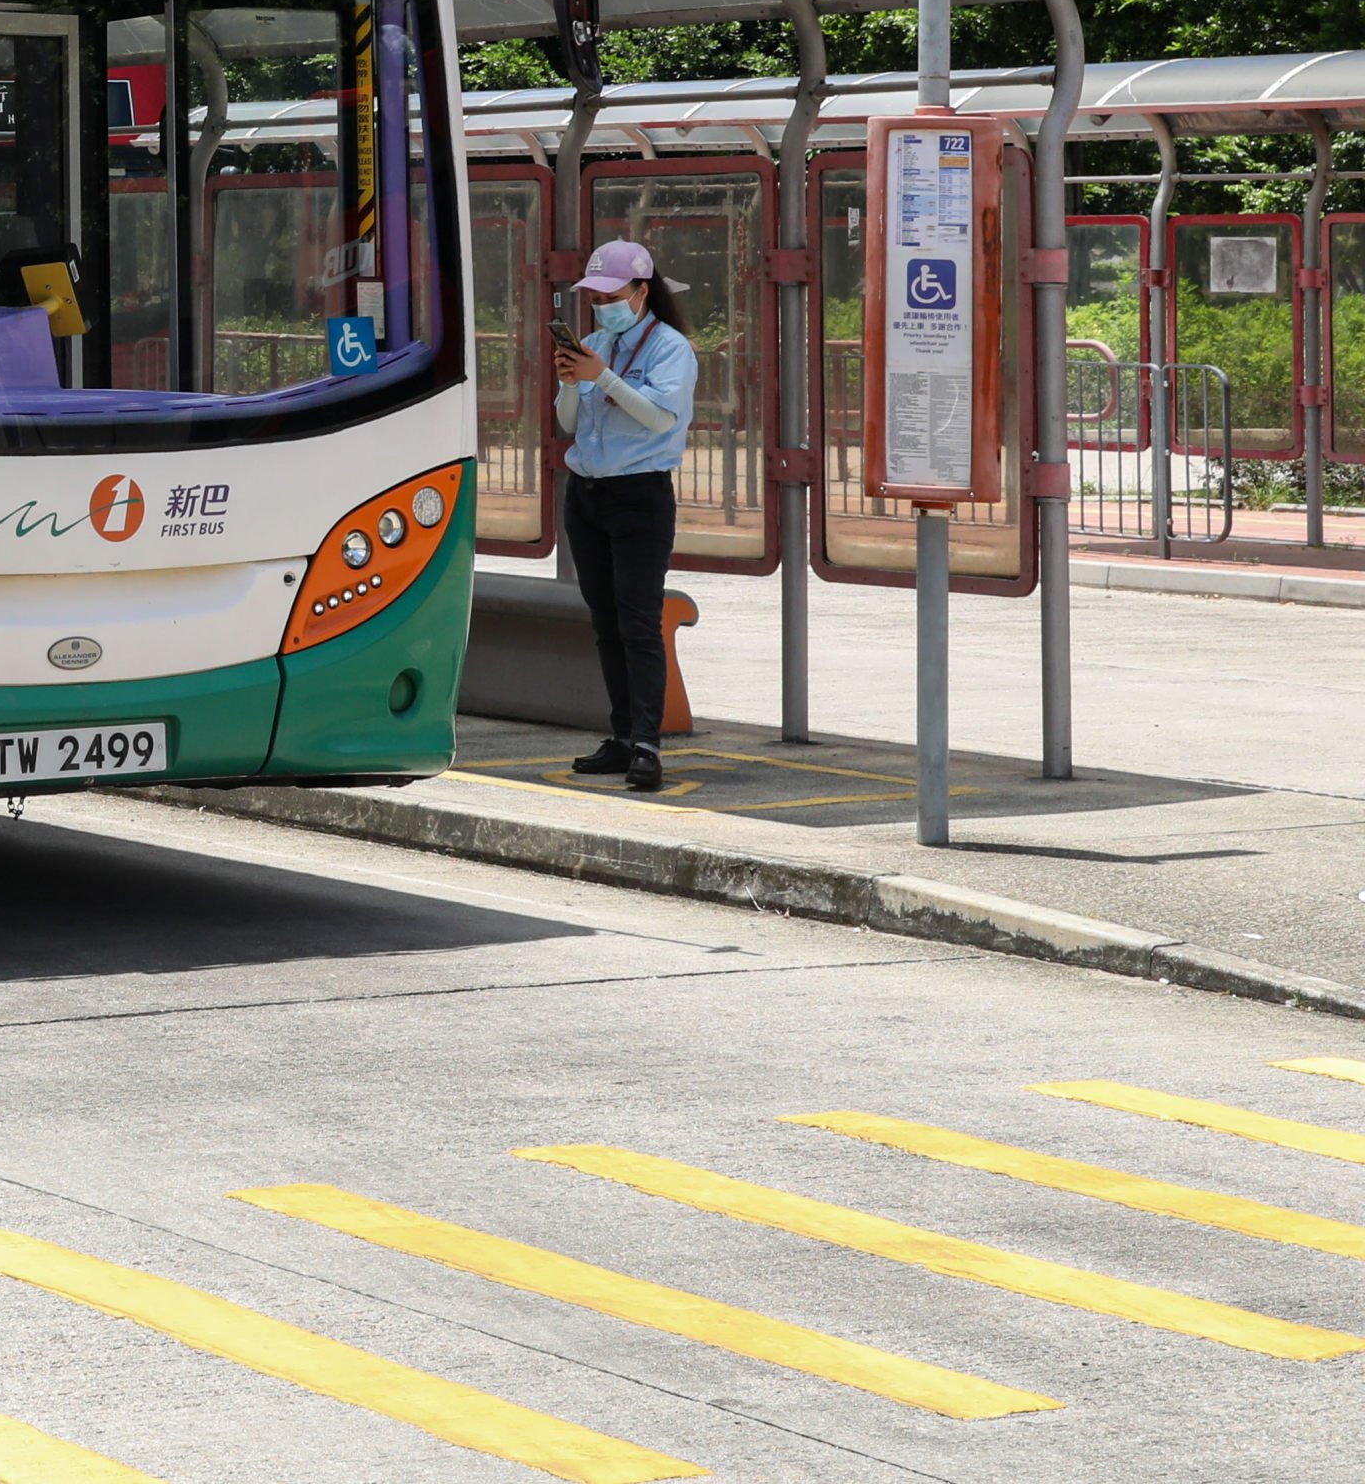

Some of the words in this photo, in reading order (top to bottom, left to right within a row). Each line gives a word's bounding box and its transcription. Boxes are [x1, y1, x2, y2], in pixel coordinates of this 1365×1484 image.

[944, 137, 965, 150] 722
[165, 484, 229, 519] 新巴
[160, 523, 196, 537] FIRST
[199, 522, 224, 535] BUS
[58, 731, 154, 772] 2499
